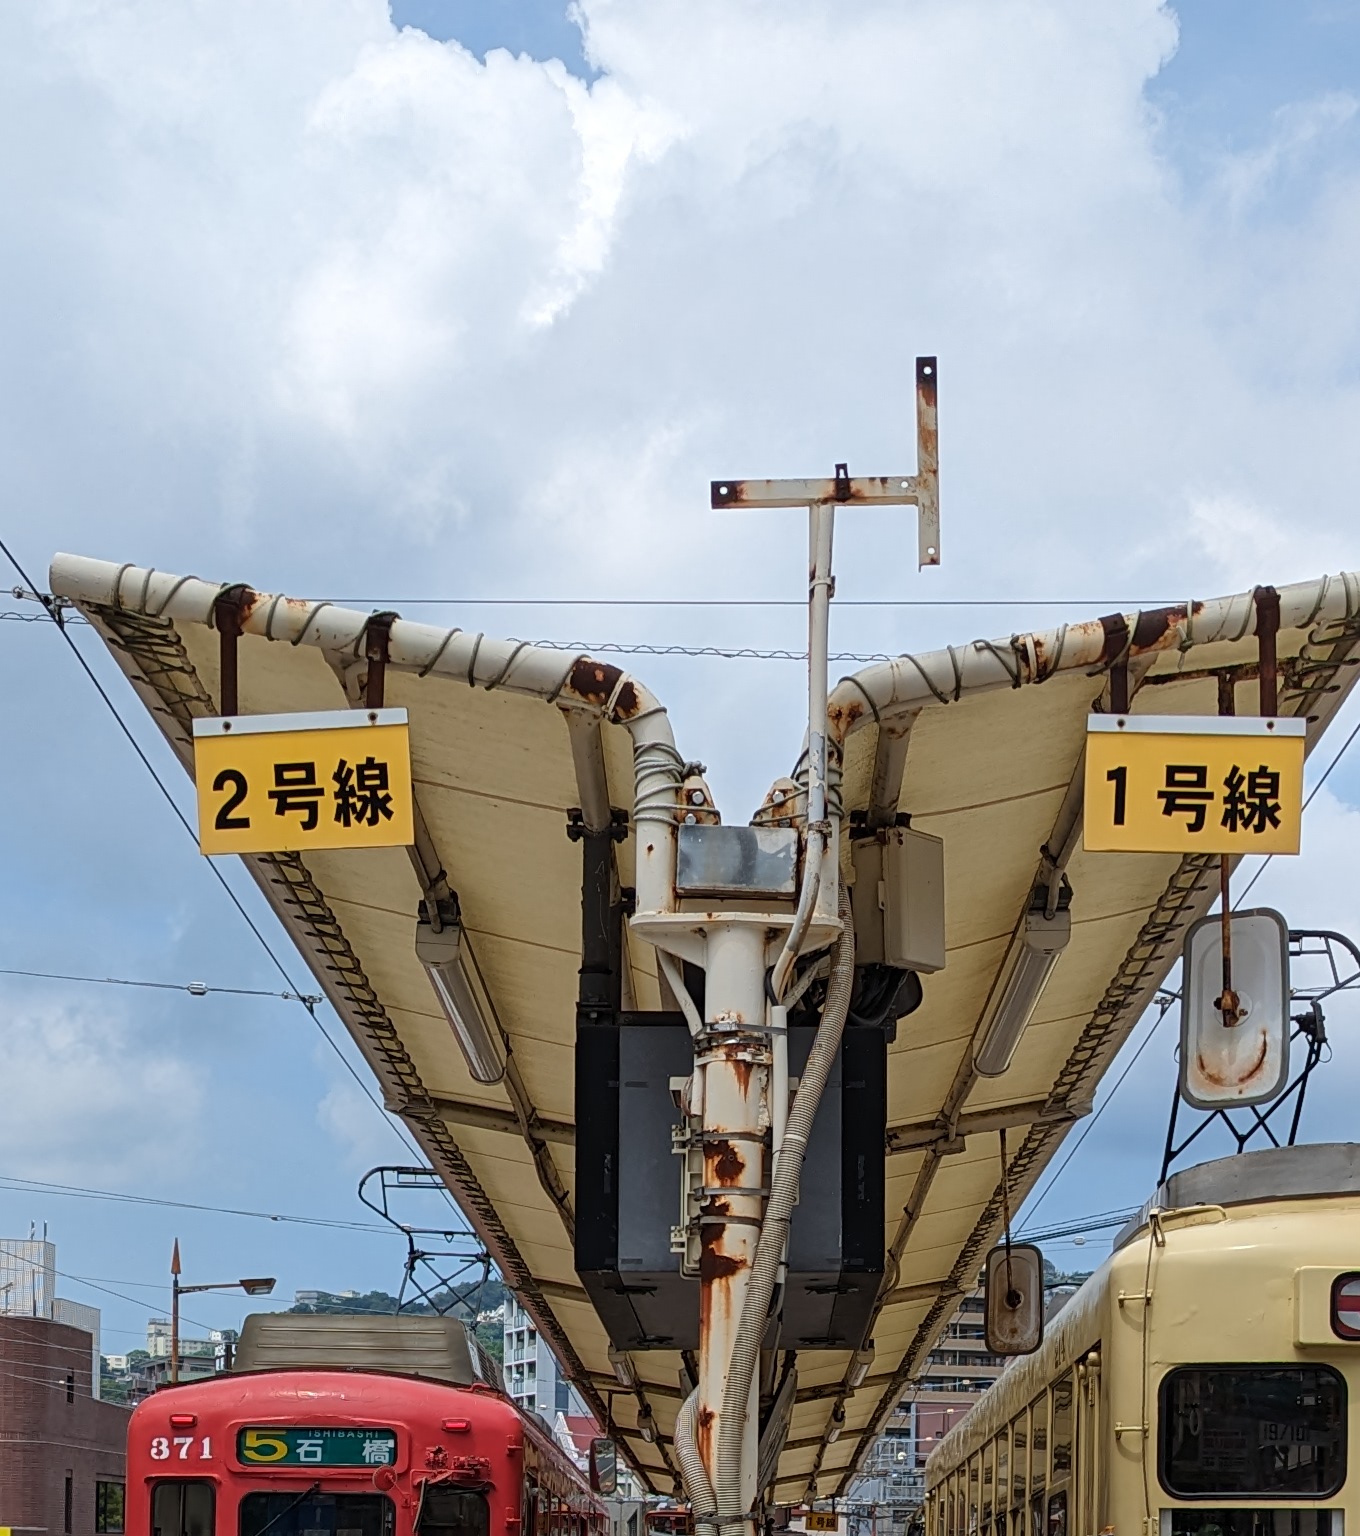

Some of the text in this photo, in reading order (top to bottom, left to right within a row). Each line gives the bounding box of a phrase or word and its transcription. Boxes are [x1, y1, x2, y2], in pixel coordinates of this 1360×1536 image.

[212, 756, 394, 831] 2号線
[1106, 764, 1282, 834] 1号線
[150, 1436, 214, 1460] 371
[243, 1430, 289, 1462] 5
[308, 1430, 379, 1439] ISHIBASHI
